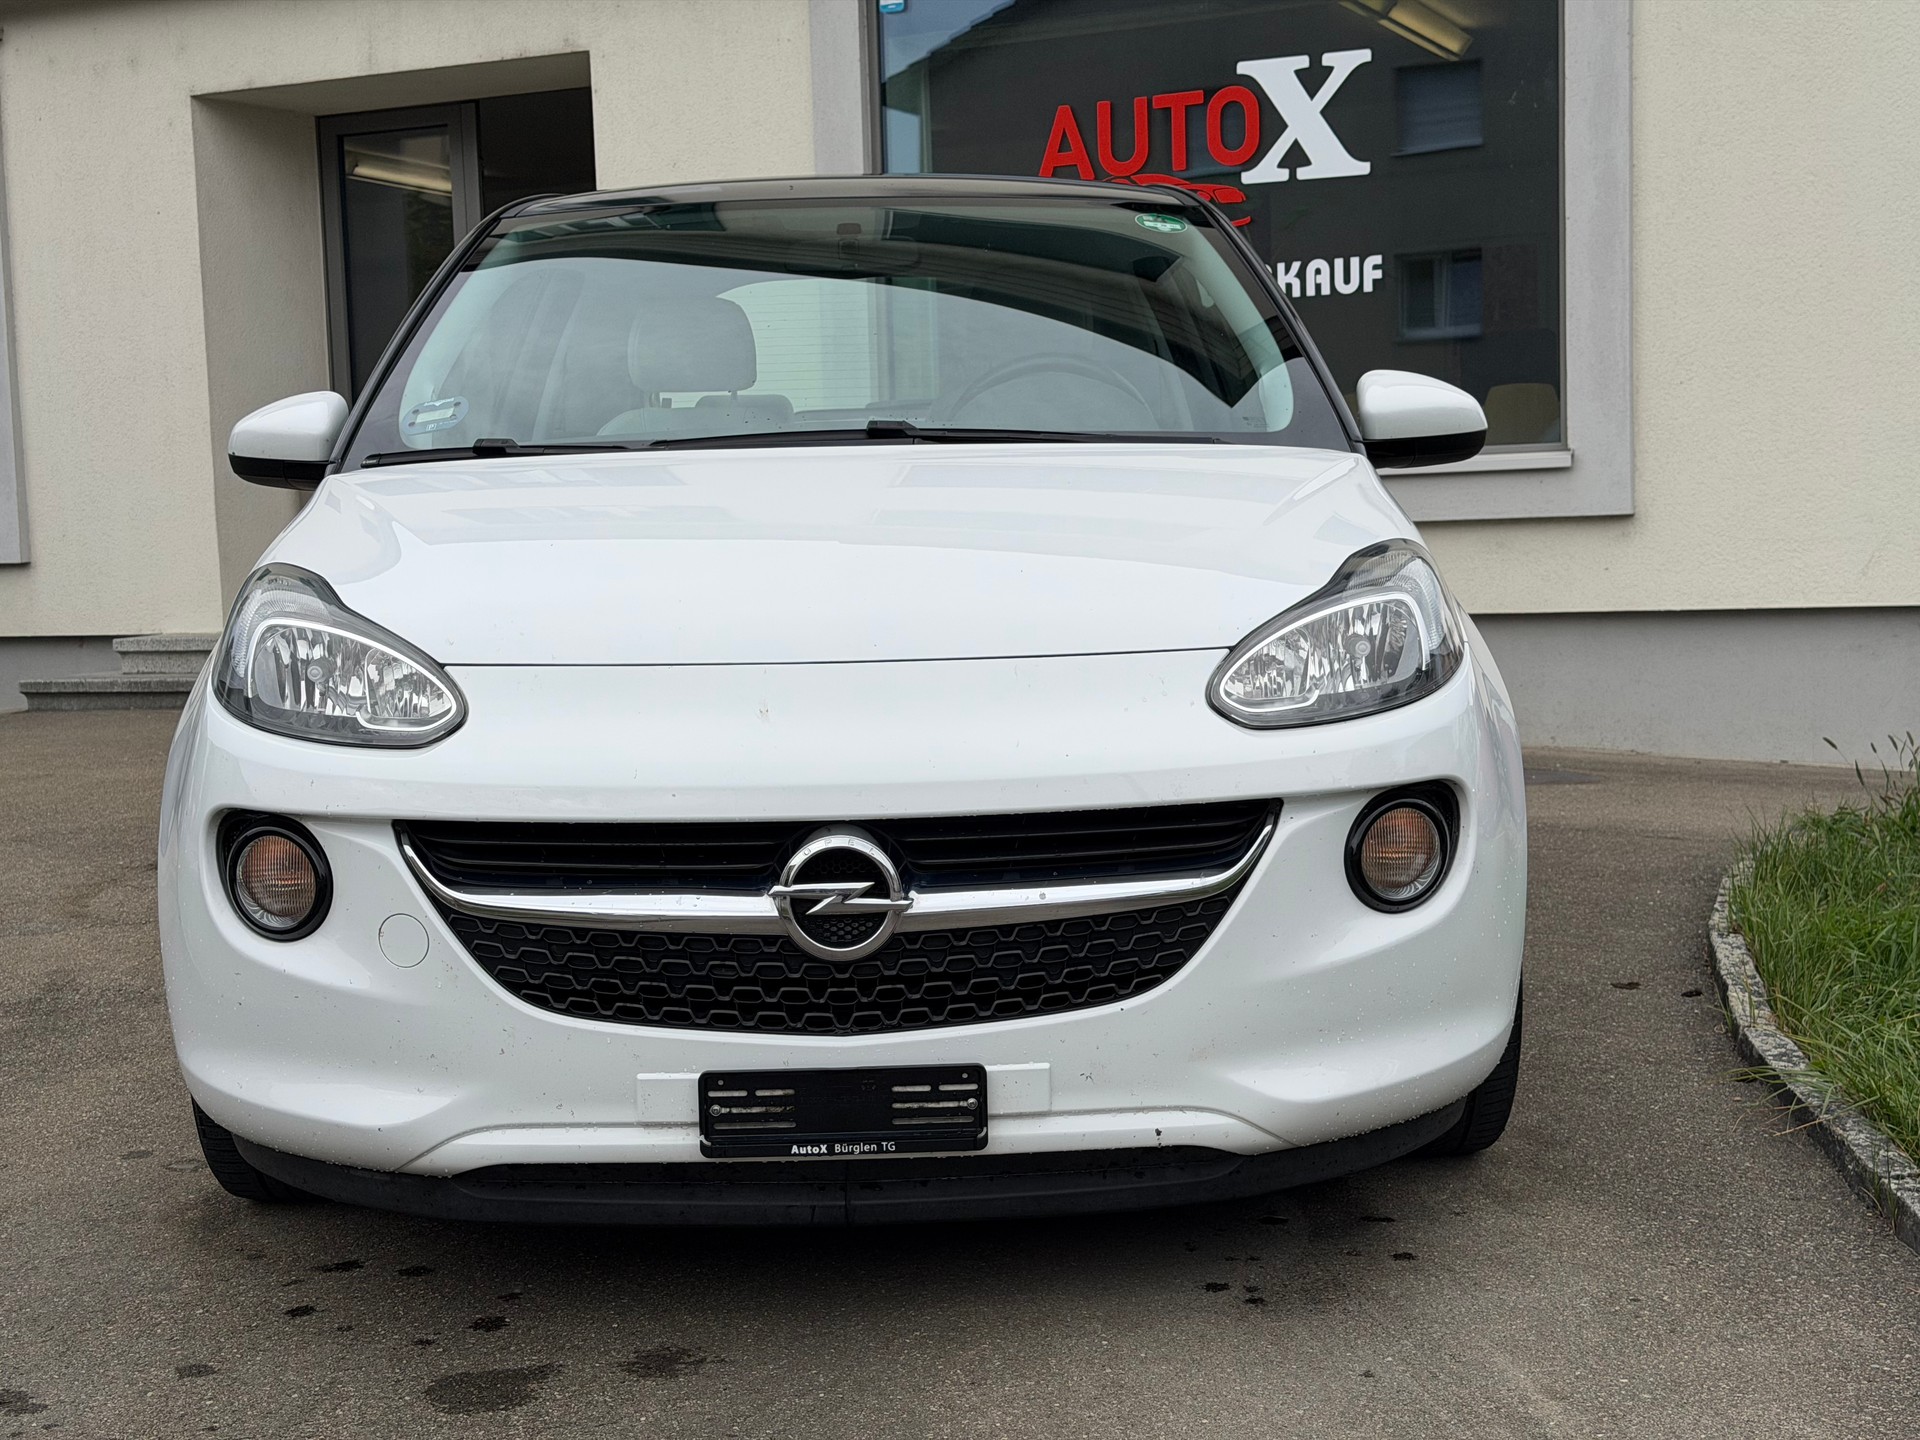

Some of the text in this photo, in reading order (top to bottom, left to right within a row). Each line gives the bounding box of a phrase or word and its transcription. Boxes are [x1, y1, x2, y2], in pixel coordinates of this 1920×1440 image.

[1265, 254, 1383, 298] KAUF
[803, 838, 875, 857] OPEL
[791, 1141, 896, 1155] AutoX Bürglen TG
